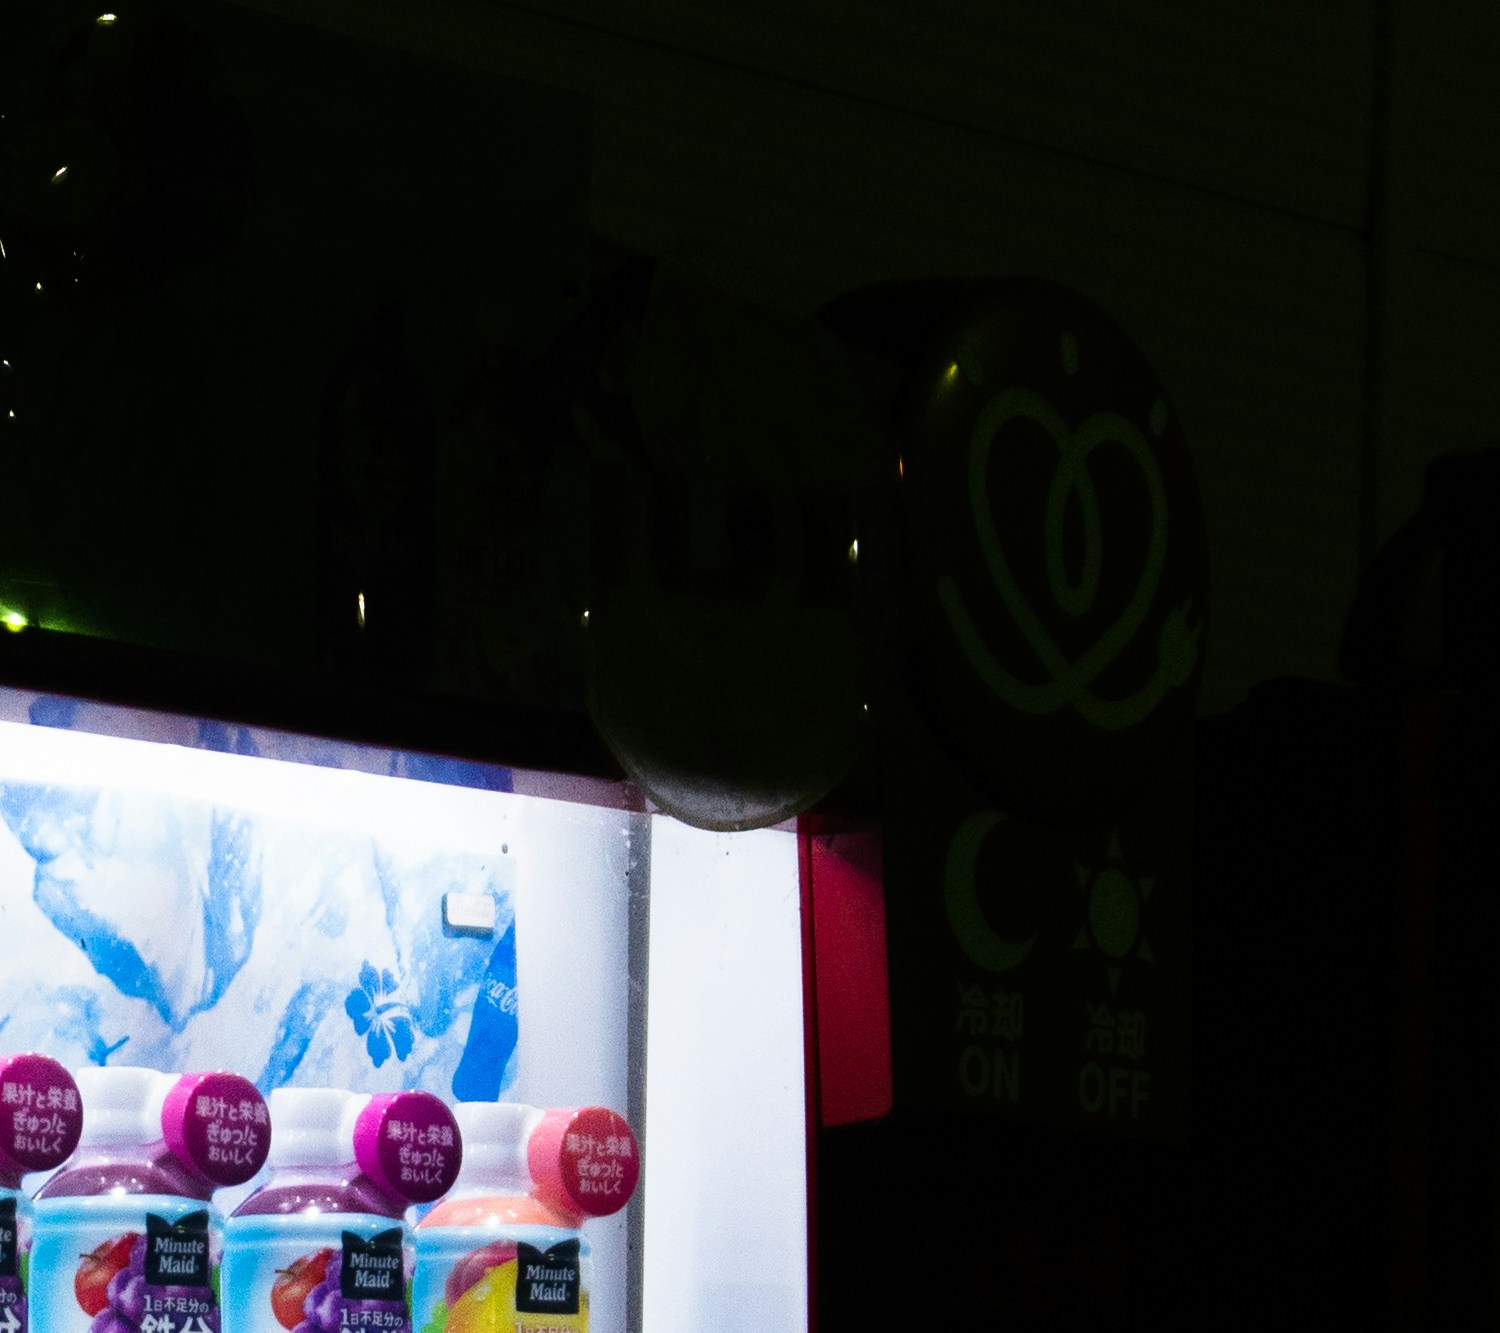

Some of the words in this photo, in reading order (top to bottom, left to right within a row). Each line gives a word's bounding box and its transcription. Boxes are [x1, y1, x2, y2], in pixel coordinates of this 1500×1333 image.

[14, 1132, 63, 1155] おいしく
[525, 1263, 576, 1283] Minute
[530, 1281, 570, 1302] Maid
